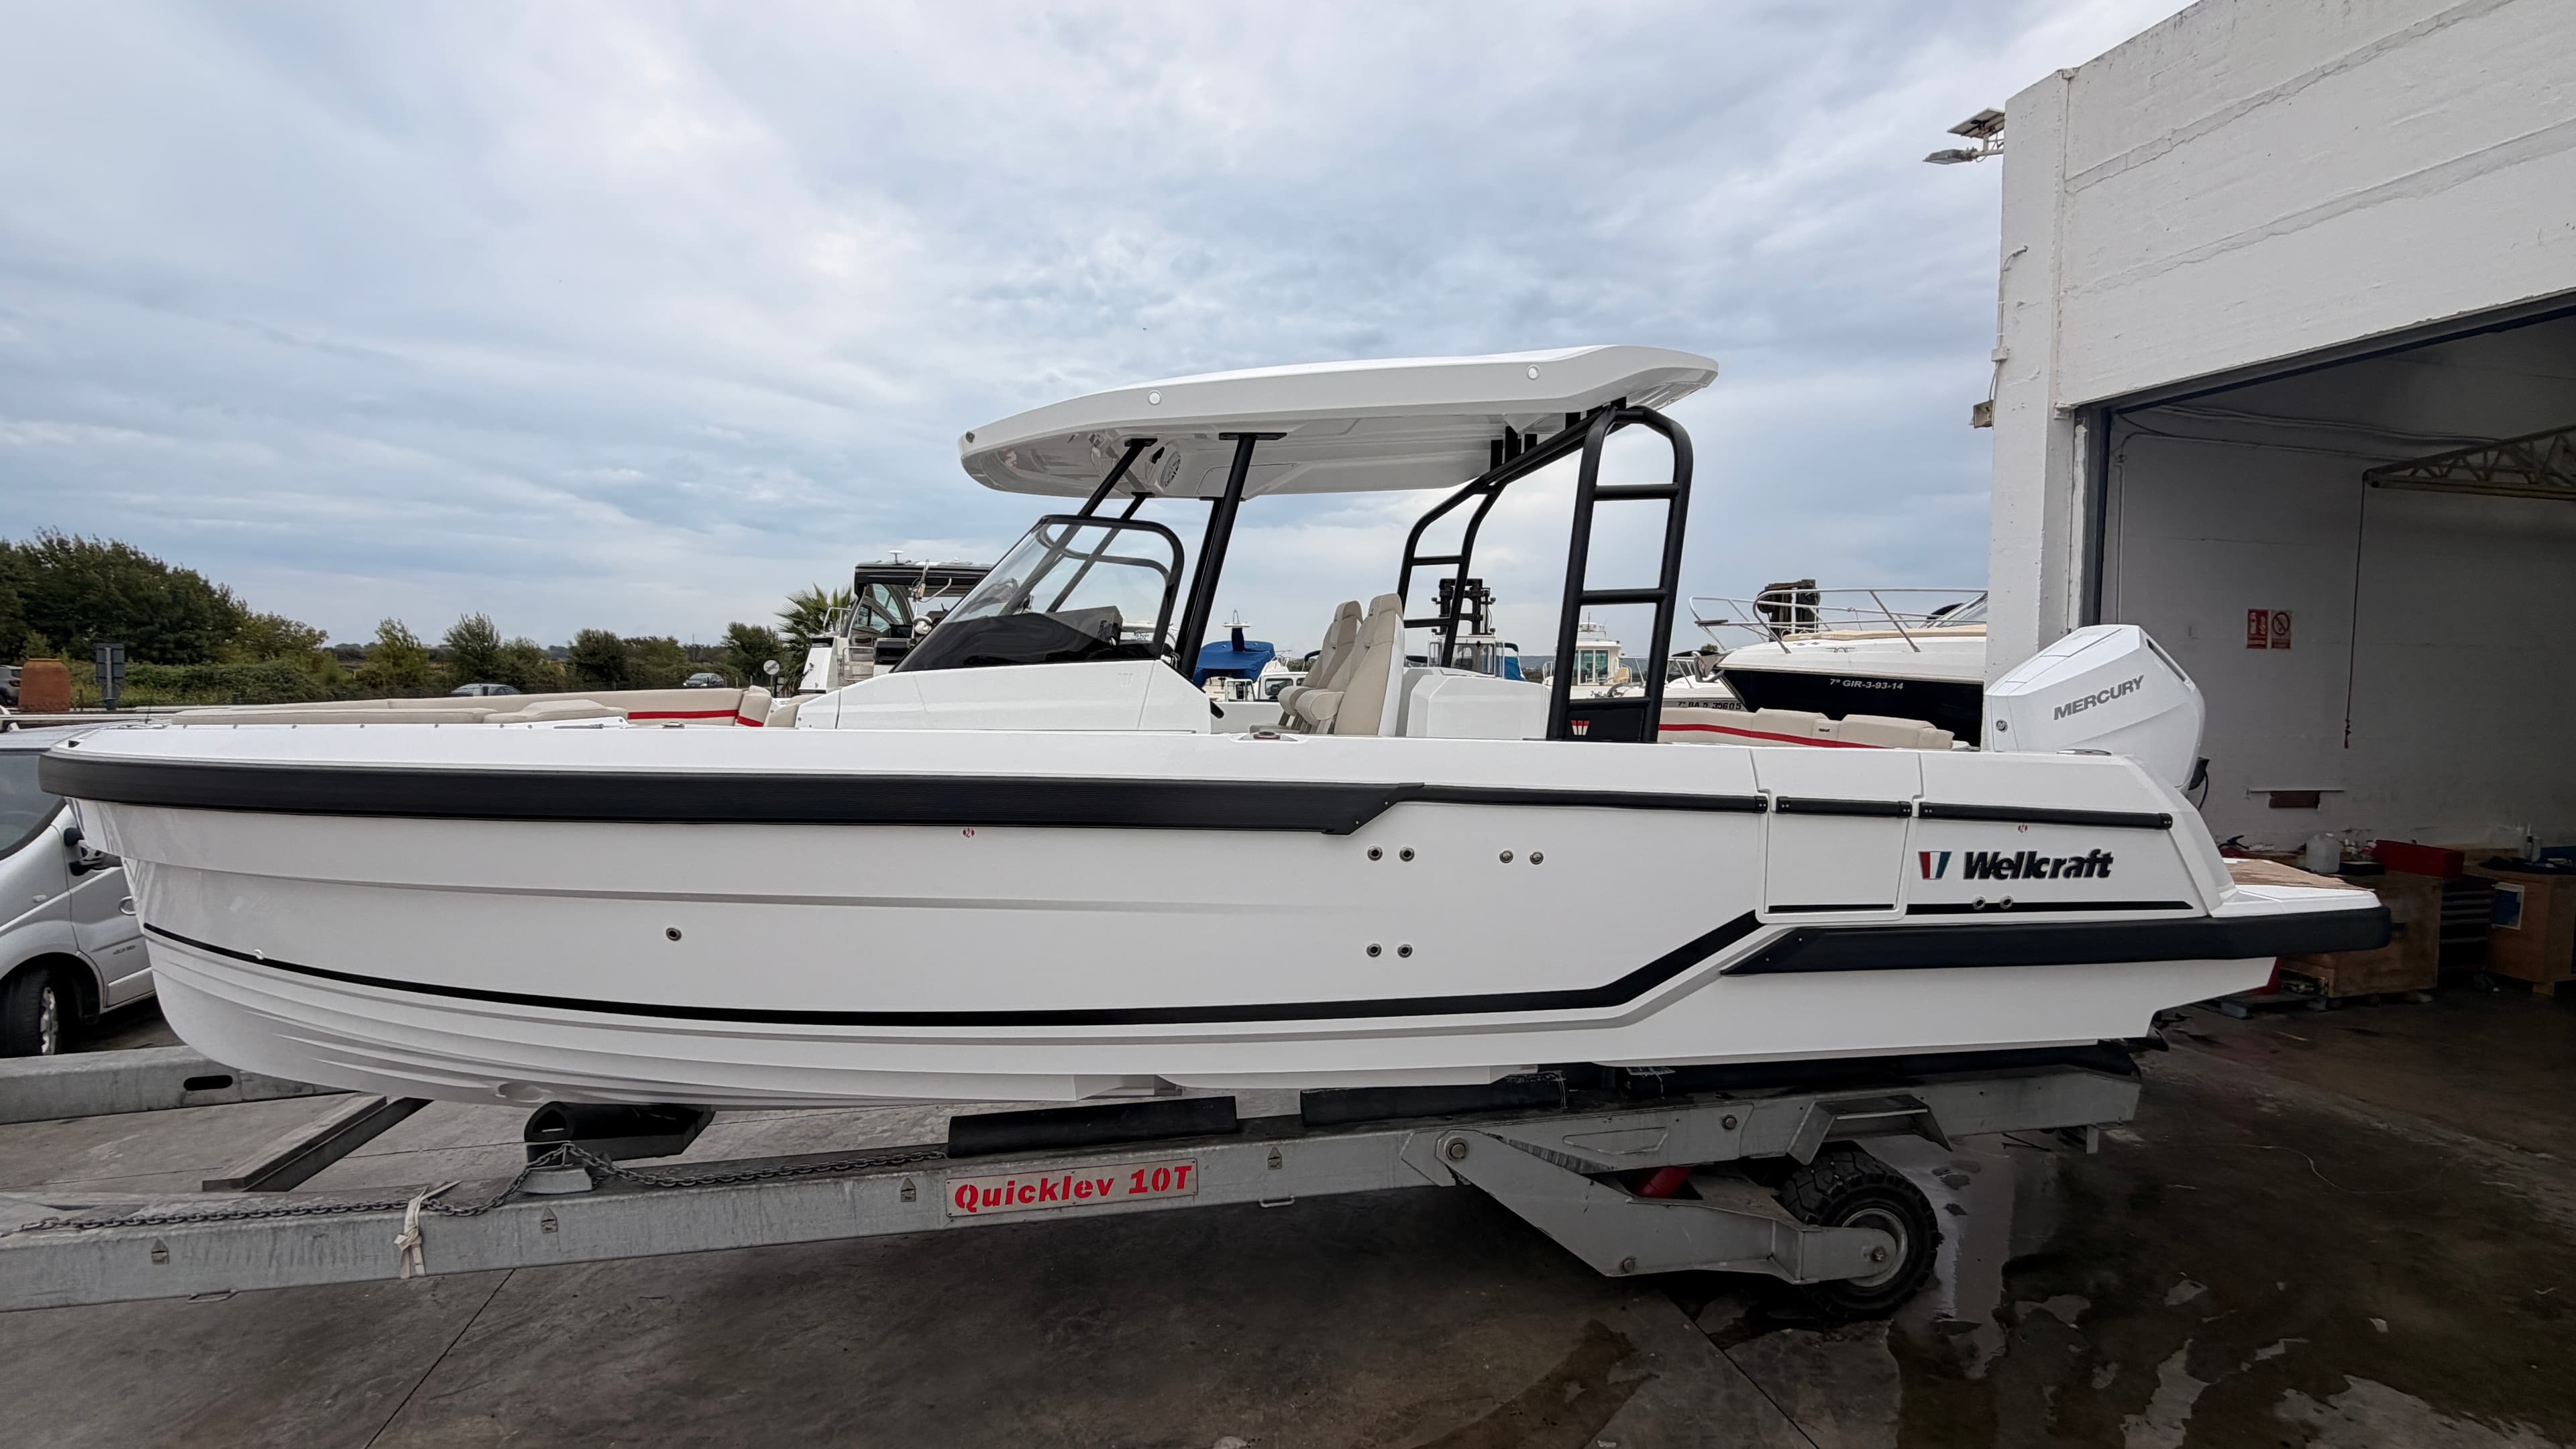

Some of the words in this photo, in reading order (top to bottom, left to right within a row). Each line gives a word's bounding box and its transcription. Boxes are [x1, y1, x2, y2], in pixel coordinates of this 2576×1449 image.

[1842, 680, 1904, 690] GIR-3-93-14
[2054, 675, 2144, 720] MERCURY
[1963, 849, 2114, 880] Wellcraft
[955, 1176, 1114, 1213] Quicklev
[1128, 1166, 1192, 1194] 10T
